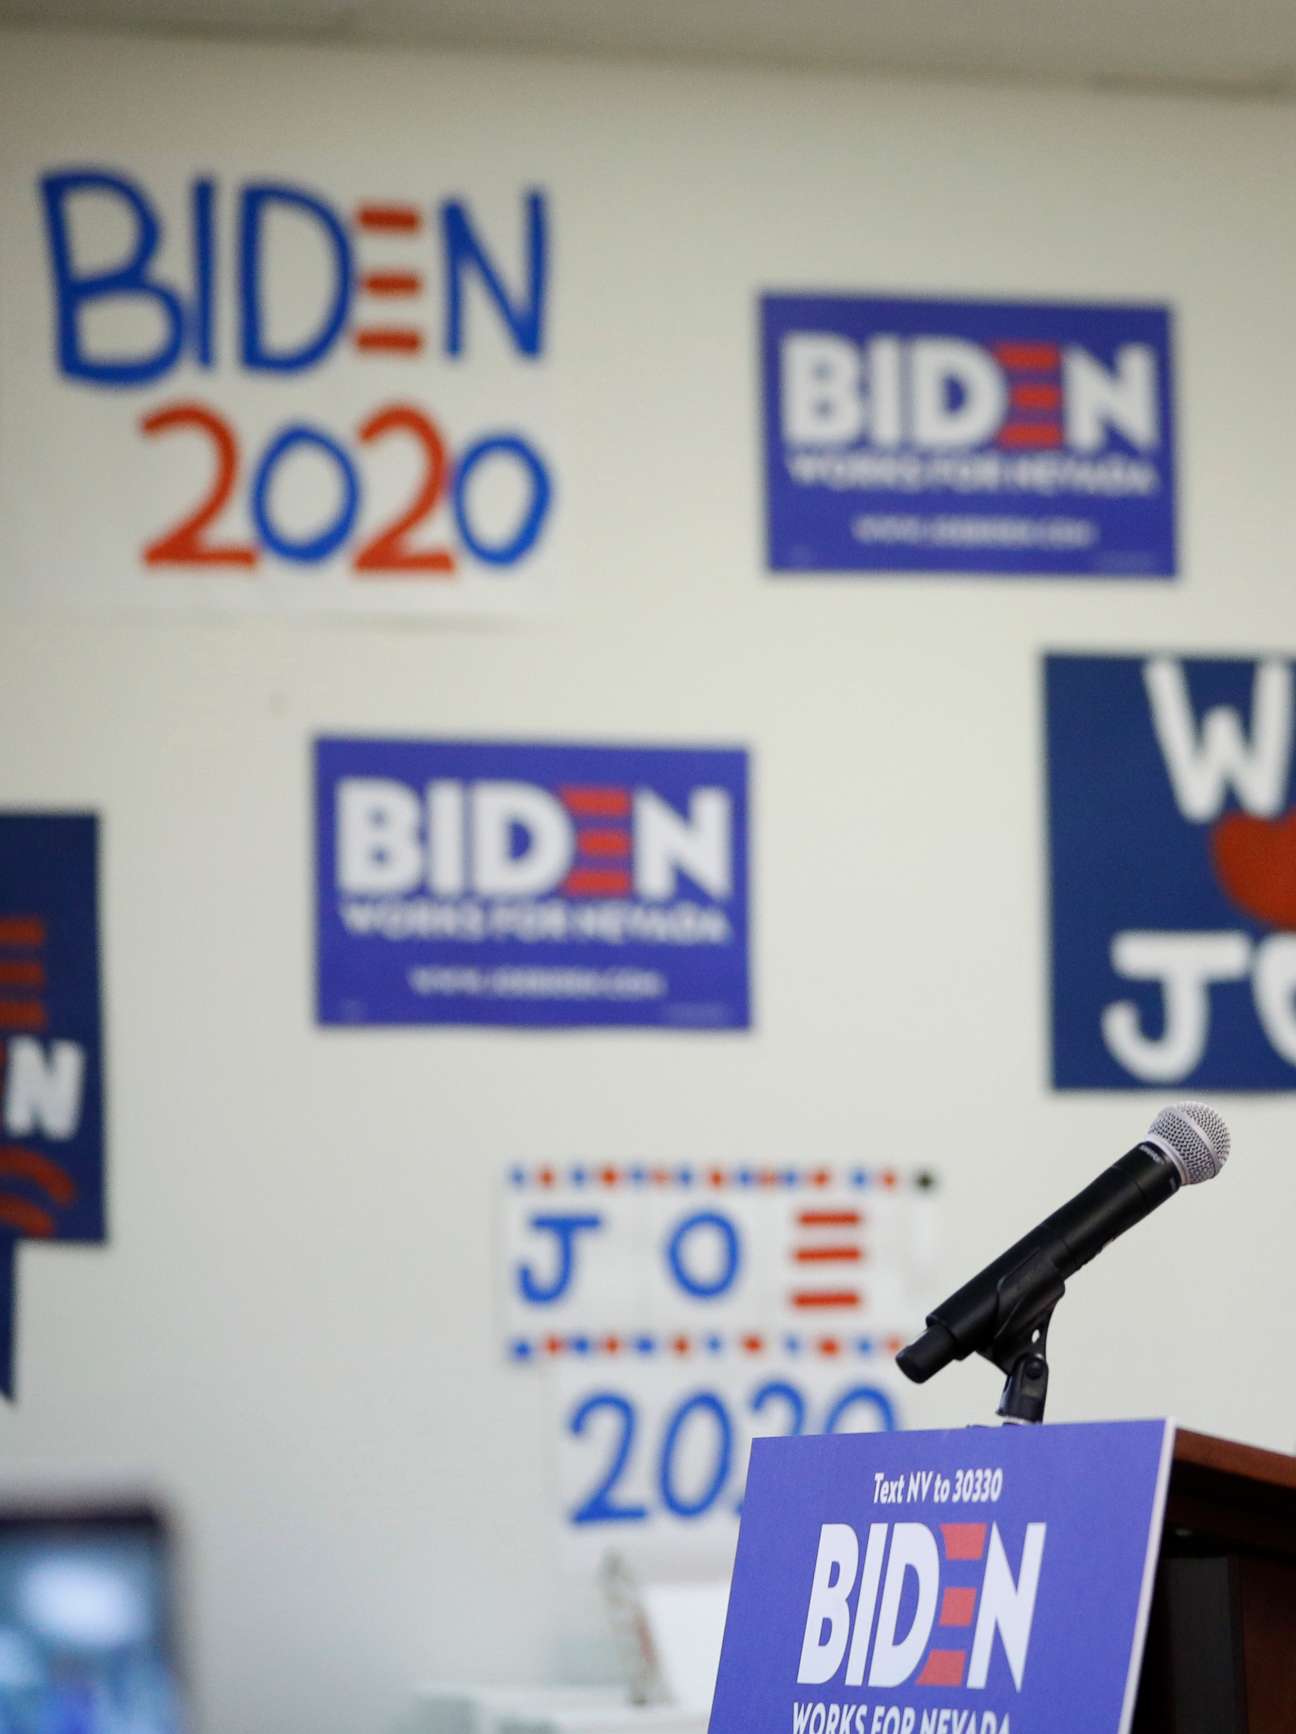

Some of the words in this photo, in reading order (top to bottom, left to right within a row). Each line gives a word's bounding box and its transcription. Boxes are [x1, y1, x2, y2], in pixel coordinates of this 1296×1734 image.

[38, 163, 549, 391] BIDEN
[782, 331, 1158, 453] BIDEN
[139, 399, 556, 576] 2020
[335, 776, 733, 901] BIDEN
[517, 1209, 864, 1311] JOE
[873, 1472, 904, 1504] Text
[906, 1470, 933, 1503] NV
[933, 1472, 950, 1503] to
[951, 1467, 1003, 1503] 30330
[796, 1521, 1047, 1692] BIDEN
[792, 1702, 867, 1734] WORKS
[870, 1705, 916, 1734] FOR
